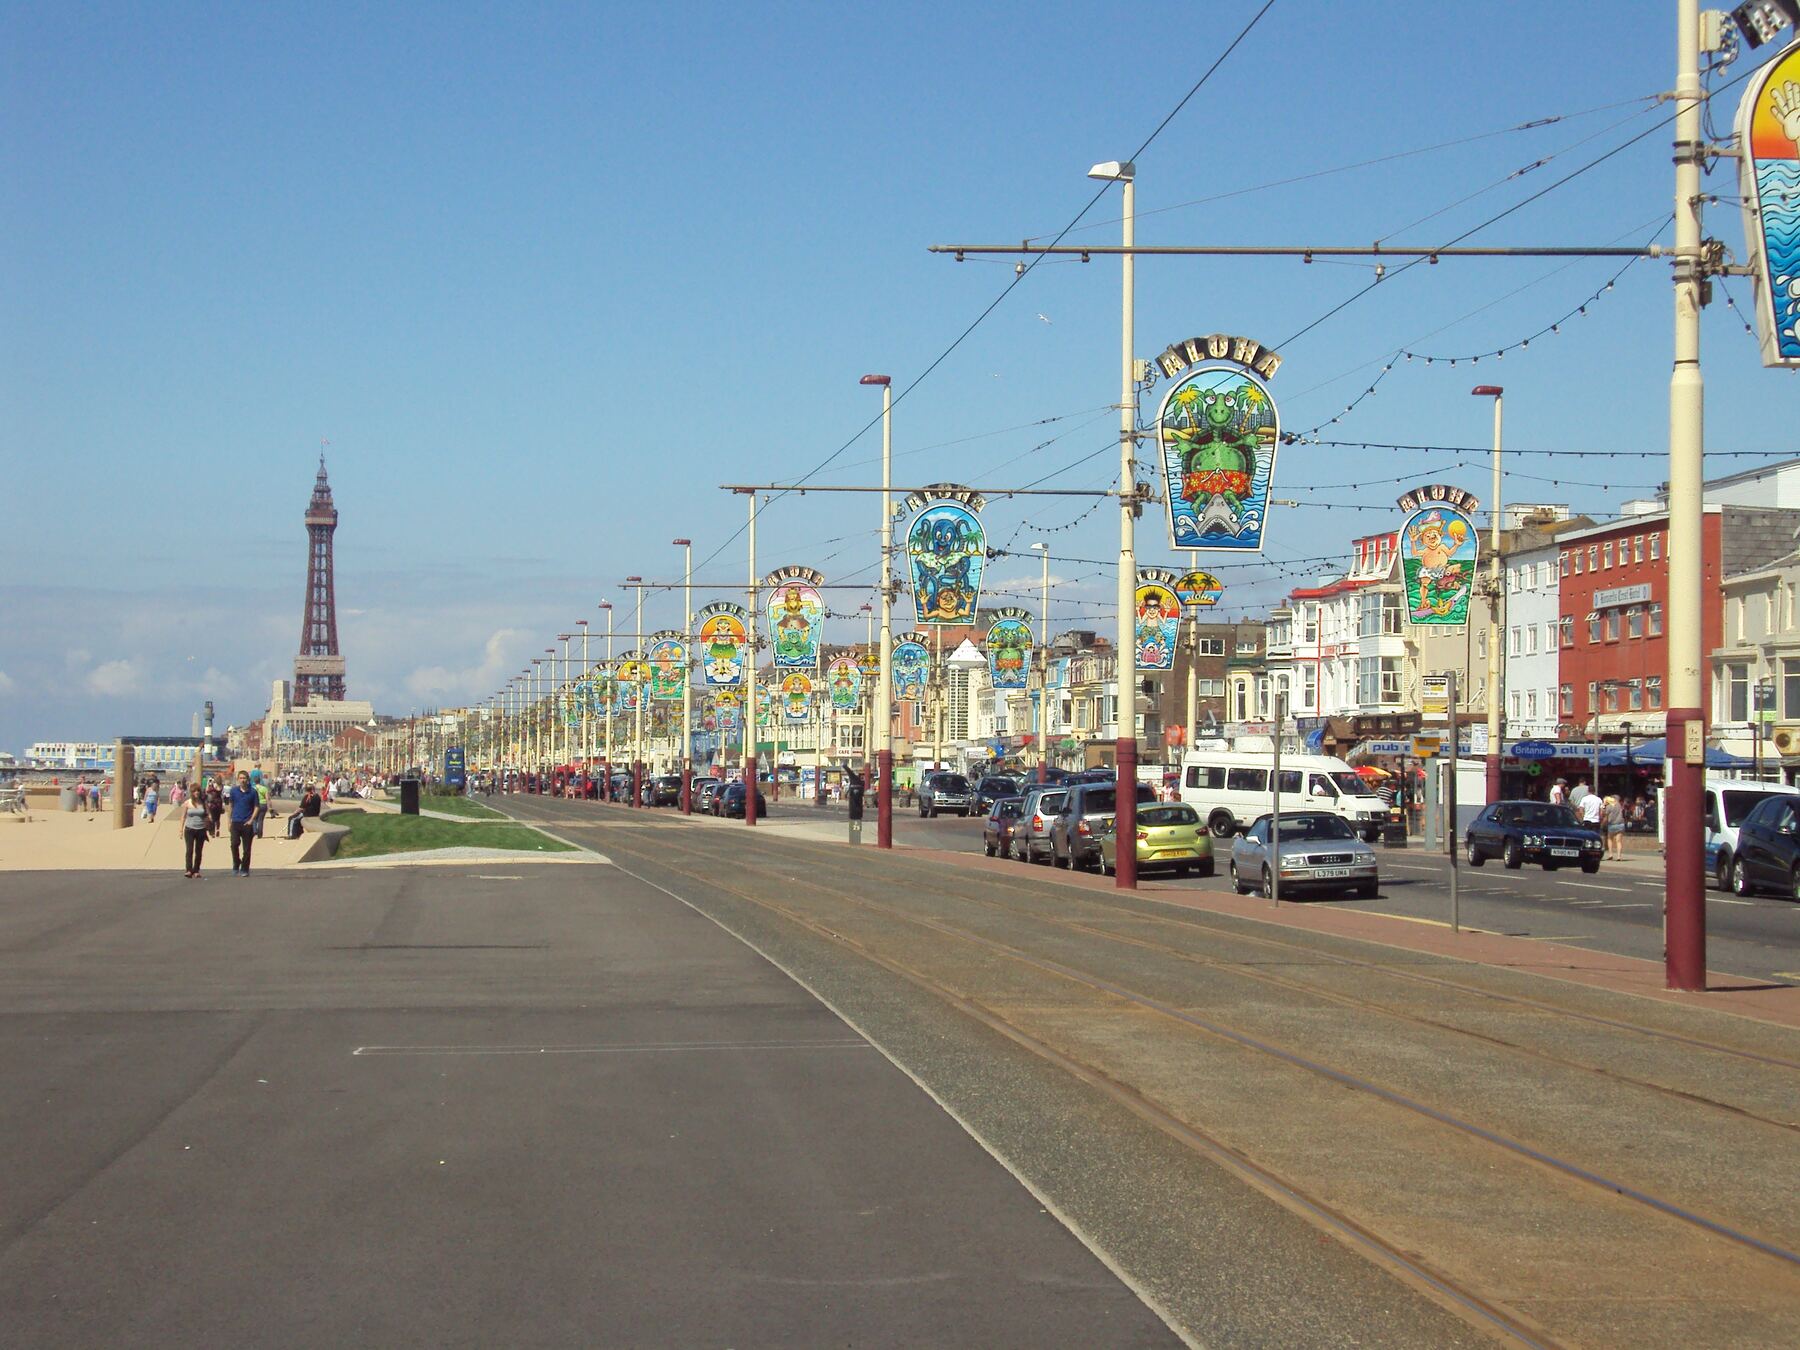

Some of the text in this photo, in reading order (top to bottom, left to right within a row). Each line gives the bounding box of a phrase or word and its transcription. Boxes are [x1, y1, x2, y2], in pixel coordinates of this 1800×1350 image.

[1155, 333, 1283, 382] ALOHA
[904, 483, 987, 513] ALOHA
[1396, 484, 1479, 516] ALOHA
[765, 566, 825, 588] ALOHA
[1185, 593, 1215, 602] ALOHA
[1372, 743, 1399, 752] pub
[1515, 745, 1553, 755] Britannia
[1561, 746, 1578, 754] all
